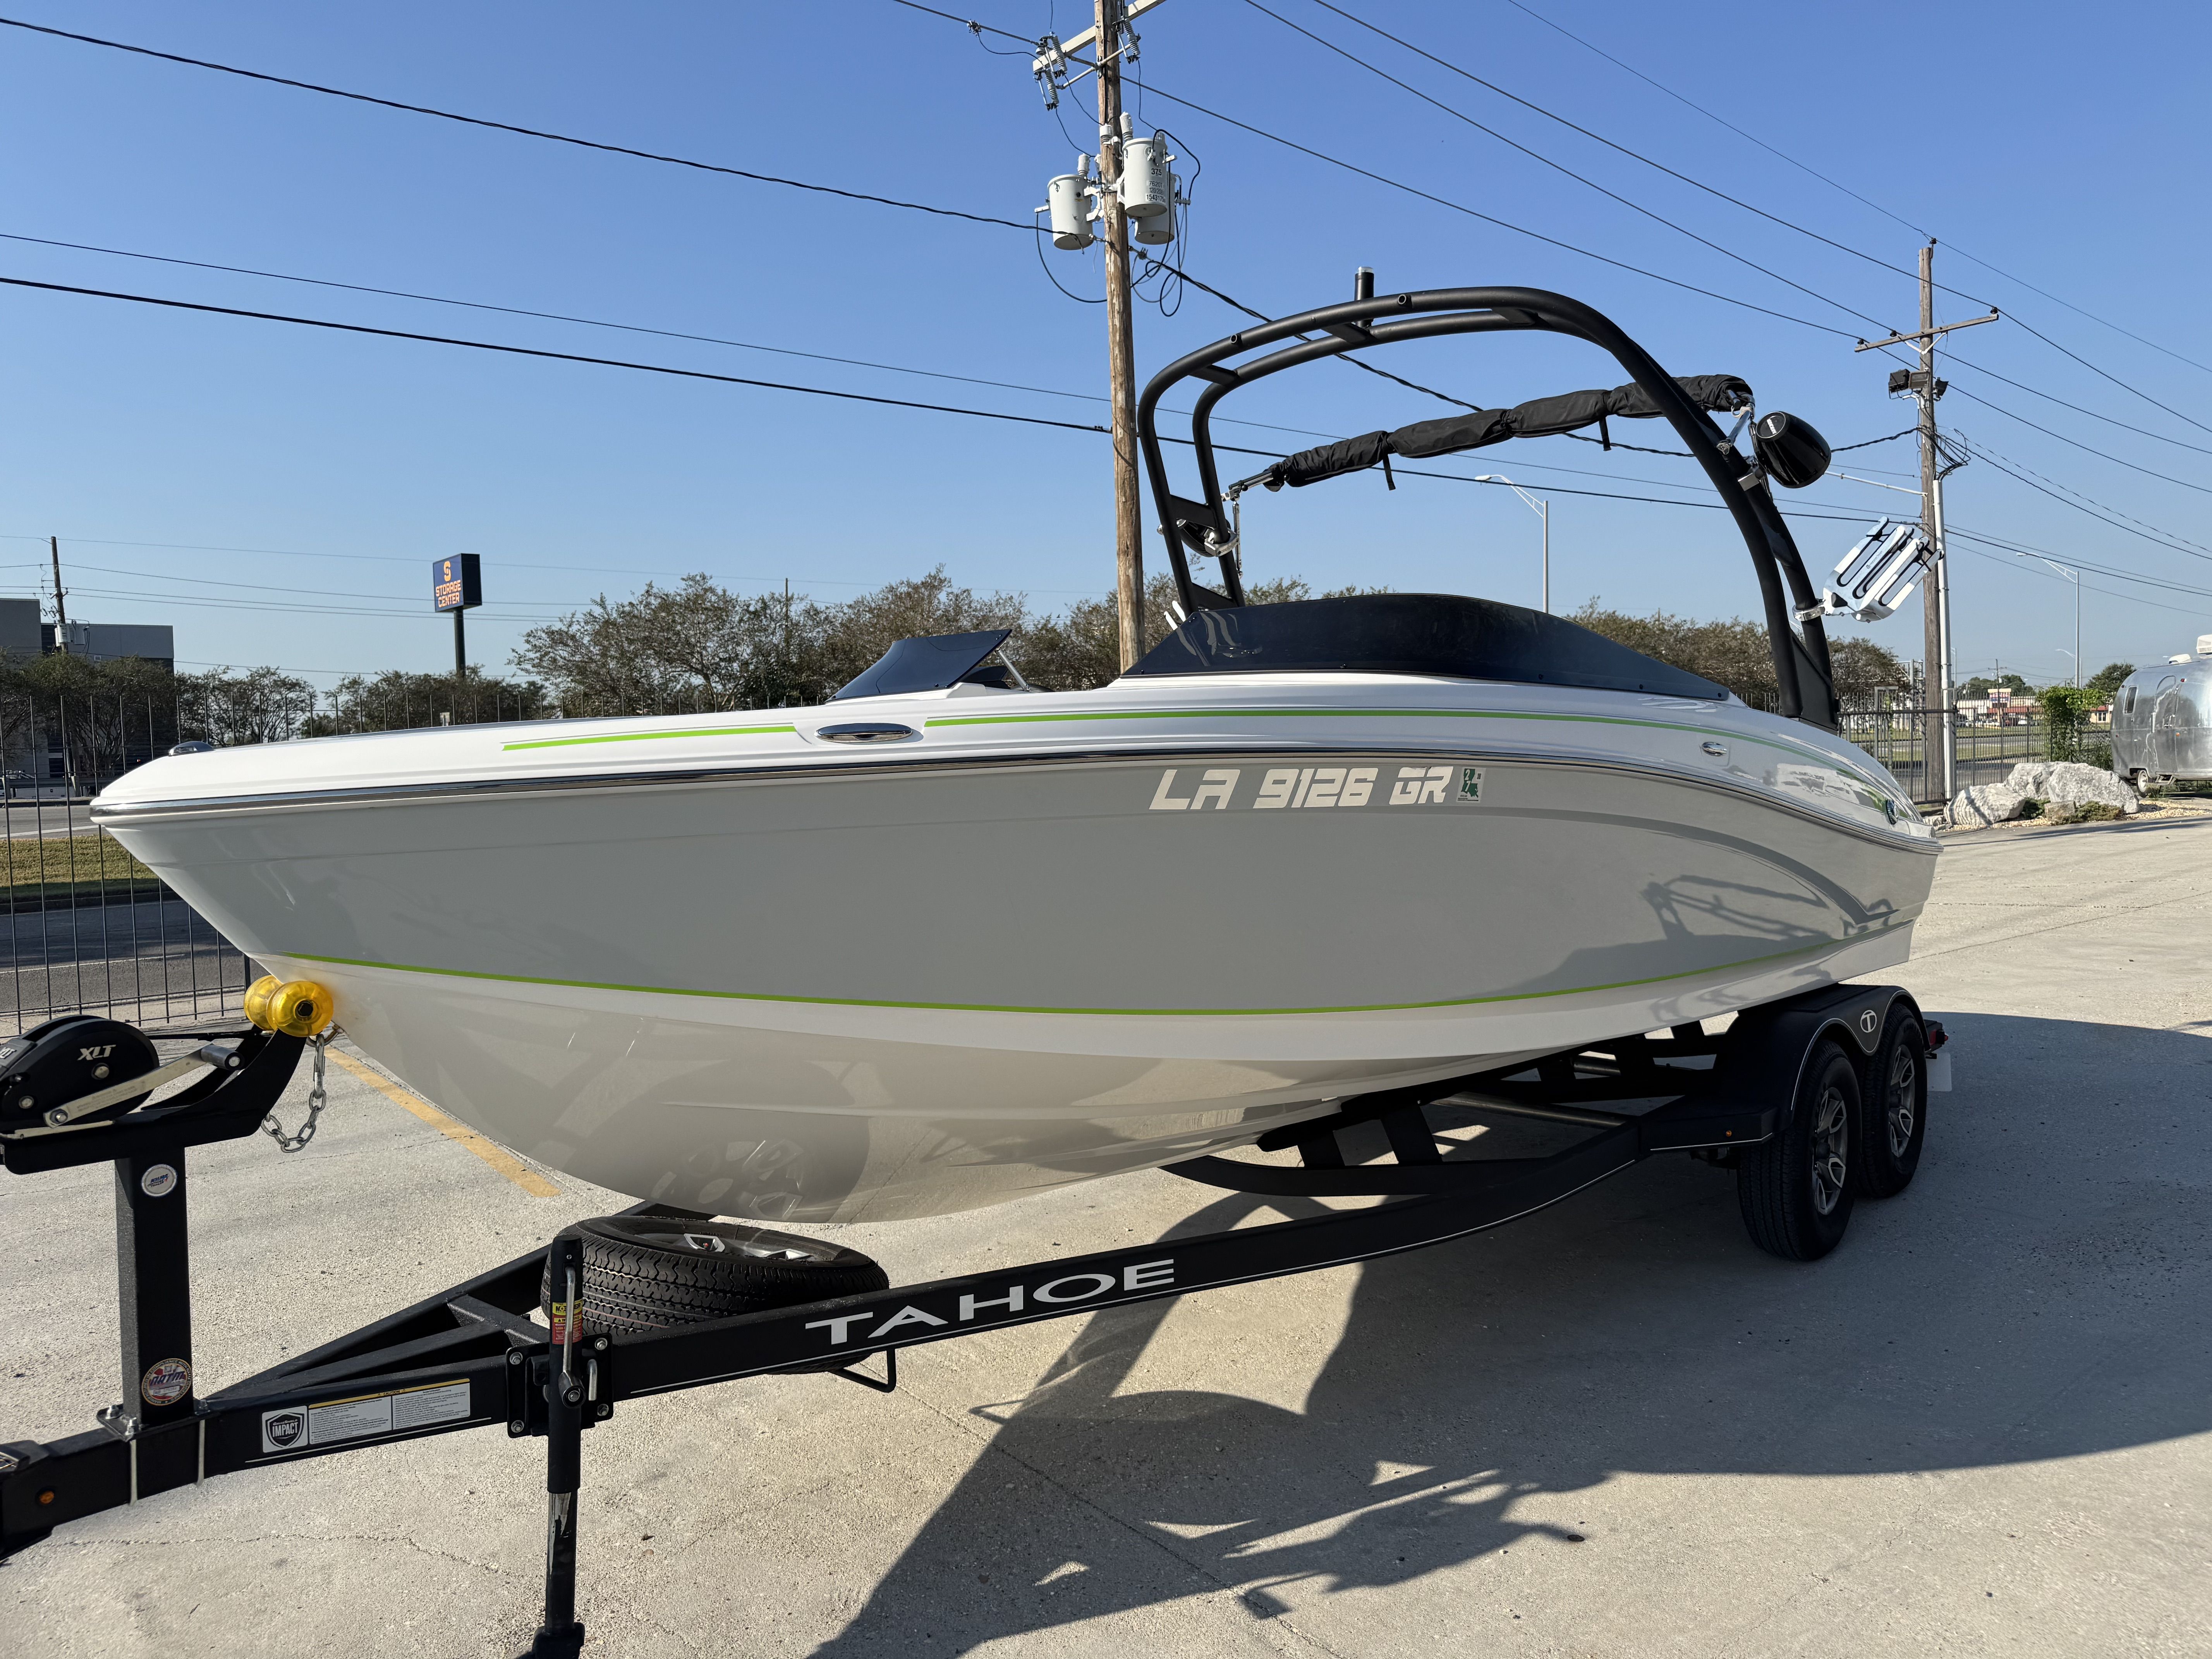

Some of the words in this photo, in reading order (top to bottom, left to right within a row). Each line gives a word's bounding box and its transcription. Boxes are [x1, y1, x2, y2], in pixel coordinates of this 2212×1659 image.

[436, 580, 462, 597] STORAGE
[438, 592, 460, 608] CENTER
[1149, 769, 1240, 810] LA
[1252, 768, 1378, 809] 9126
[1389, 766, 1453, 805] GR
[77, 1044, 116, 1061] XLT
[555, 1303, 581, 1312] MOEER
[805, 1259, 1174, 1345] TAHOE
[272, 1422, 299, 1437] IMPACT
